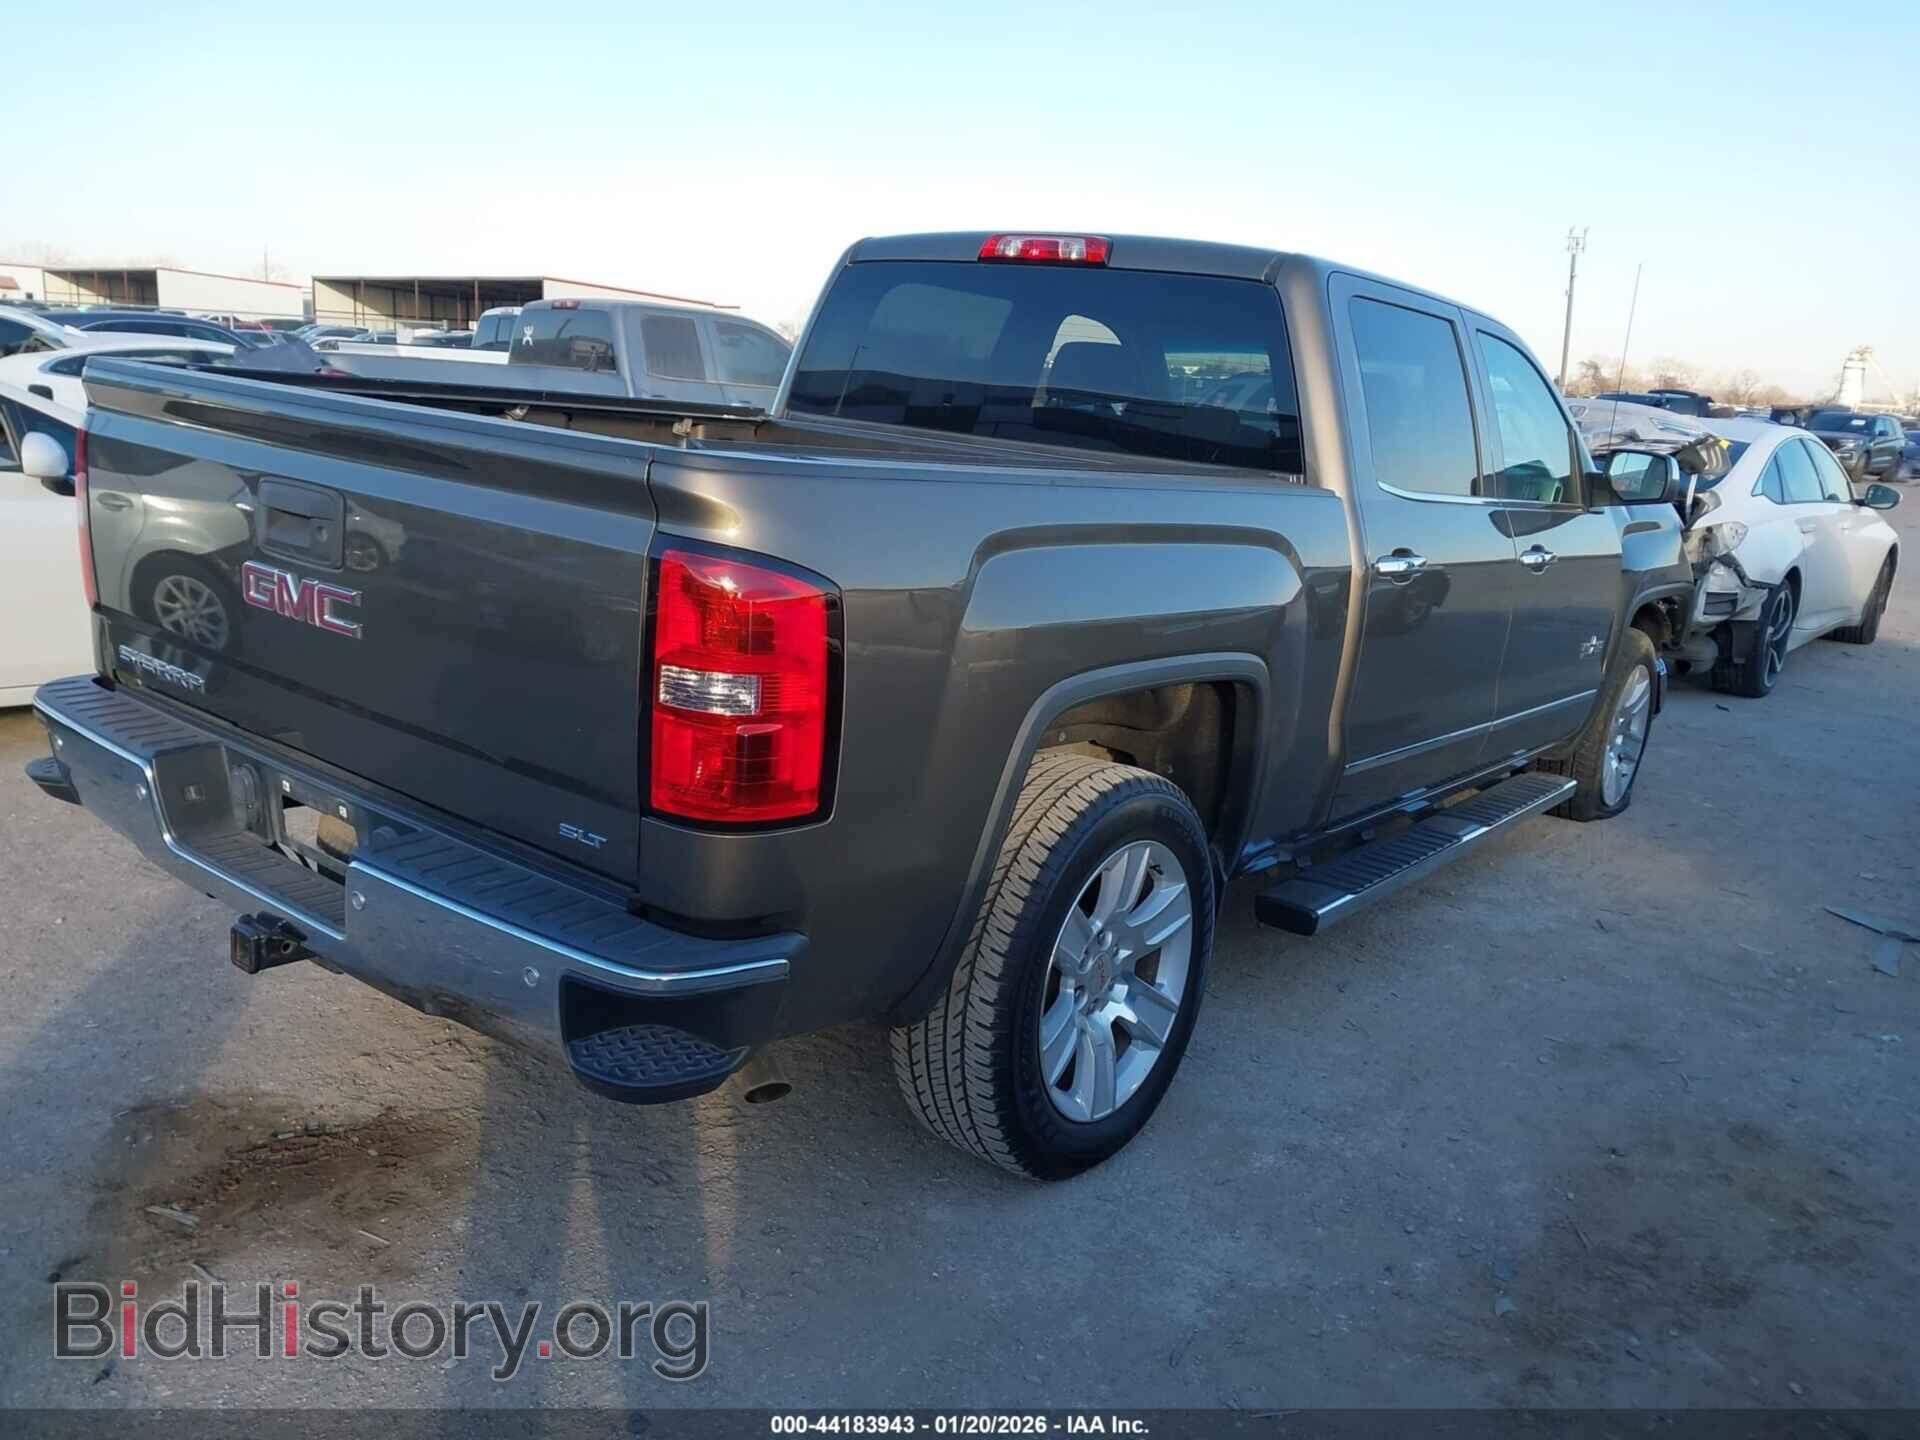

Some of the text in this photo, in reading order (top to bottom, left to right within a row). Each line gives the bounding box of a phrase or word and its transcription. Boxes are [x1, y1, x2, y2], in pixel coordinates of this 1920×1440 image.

[242, 560, 363, 640] GMC
[119, 644, 205, 694] SIERRA
[559, 822, 608, 848] SLT
